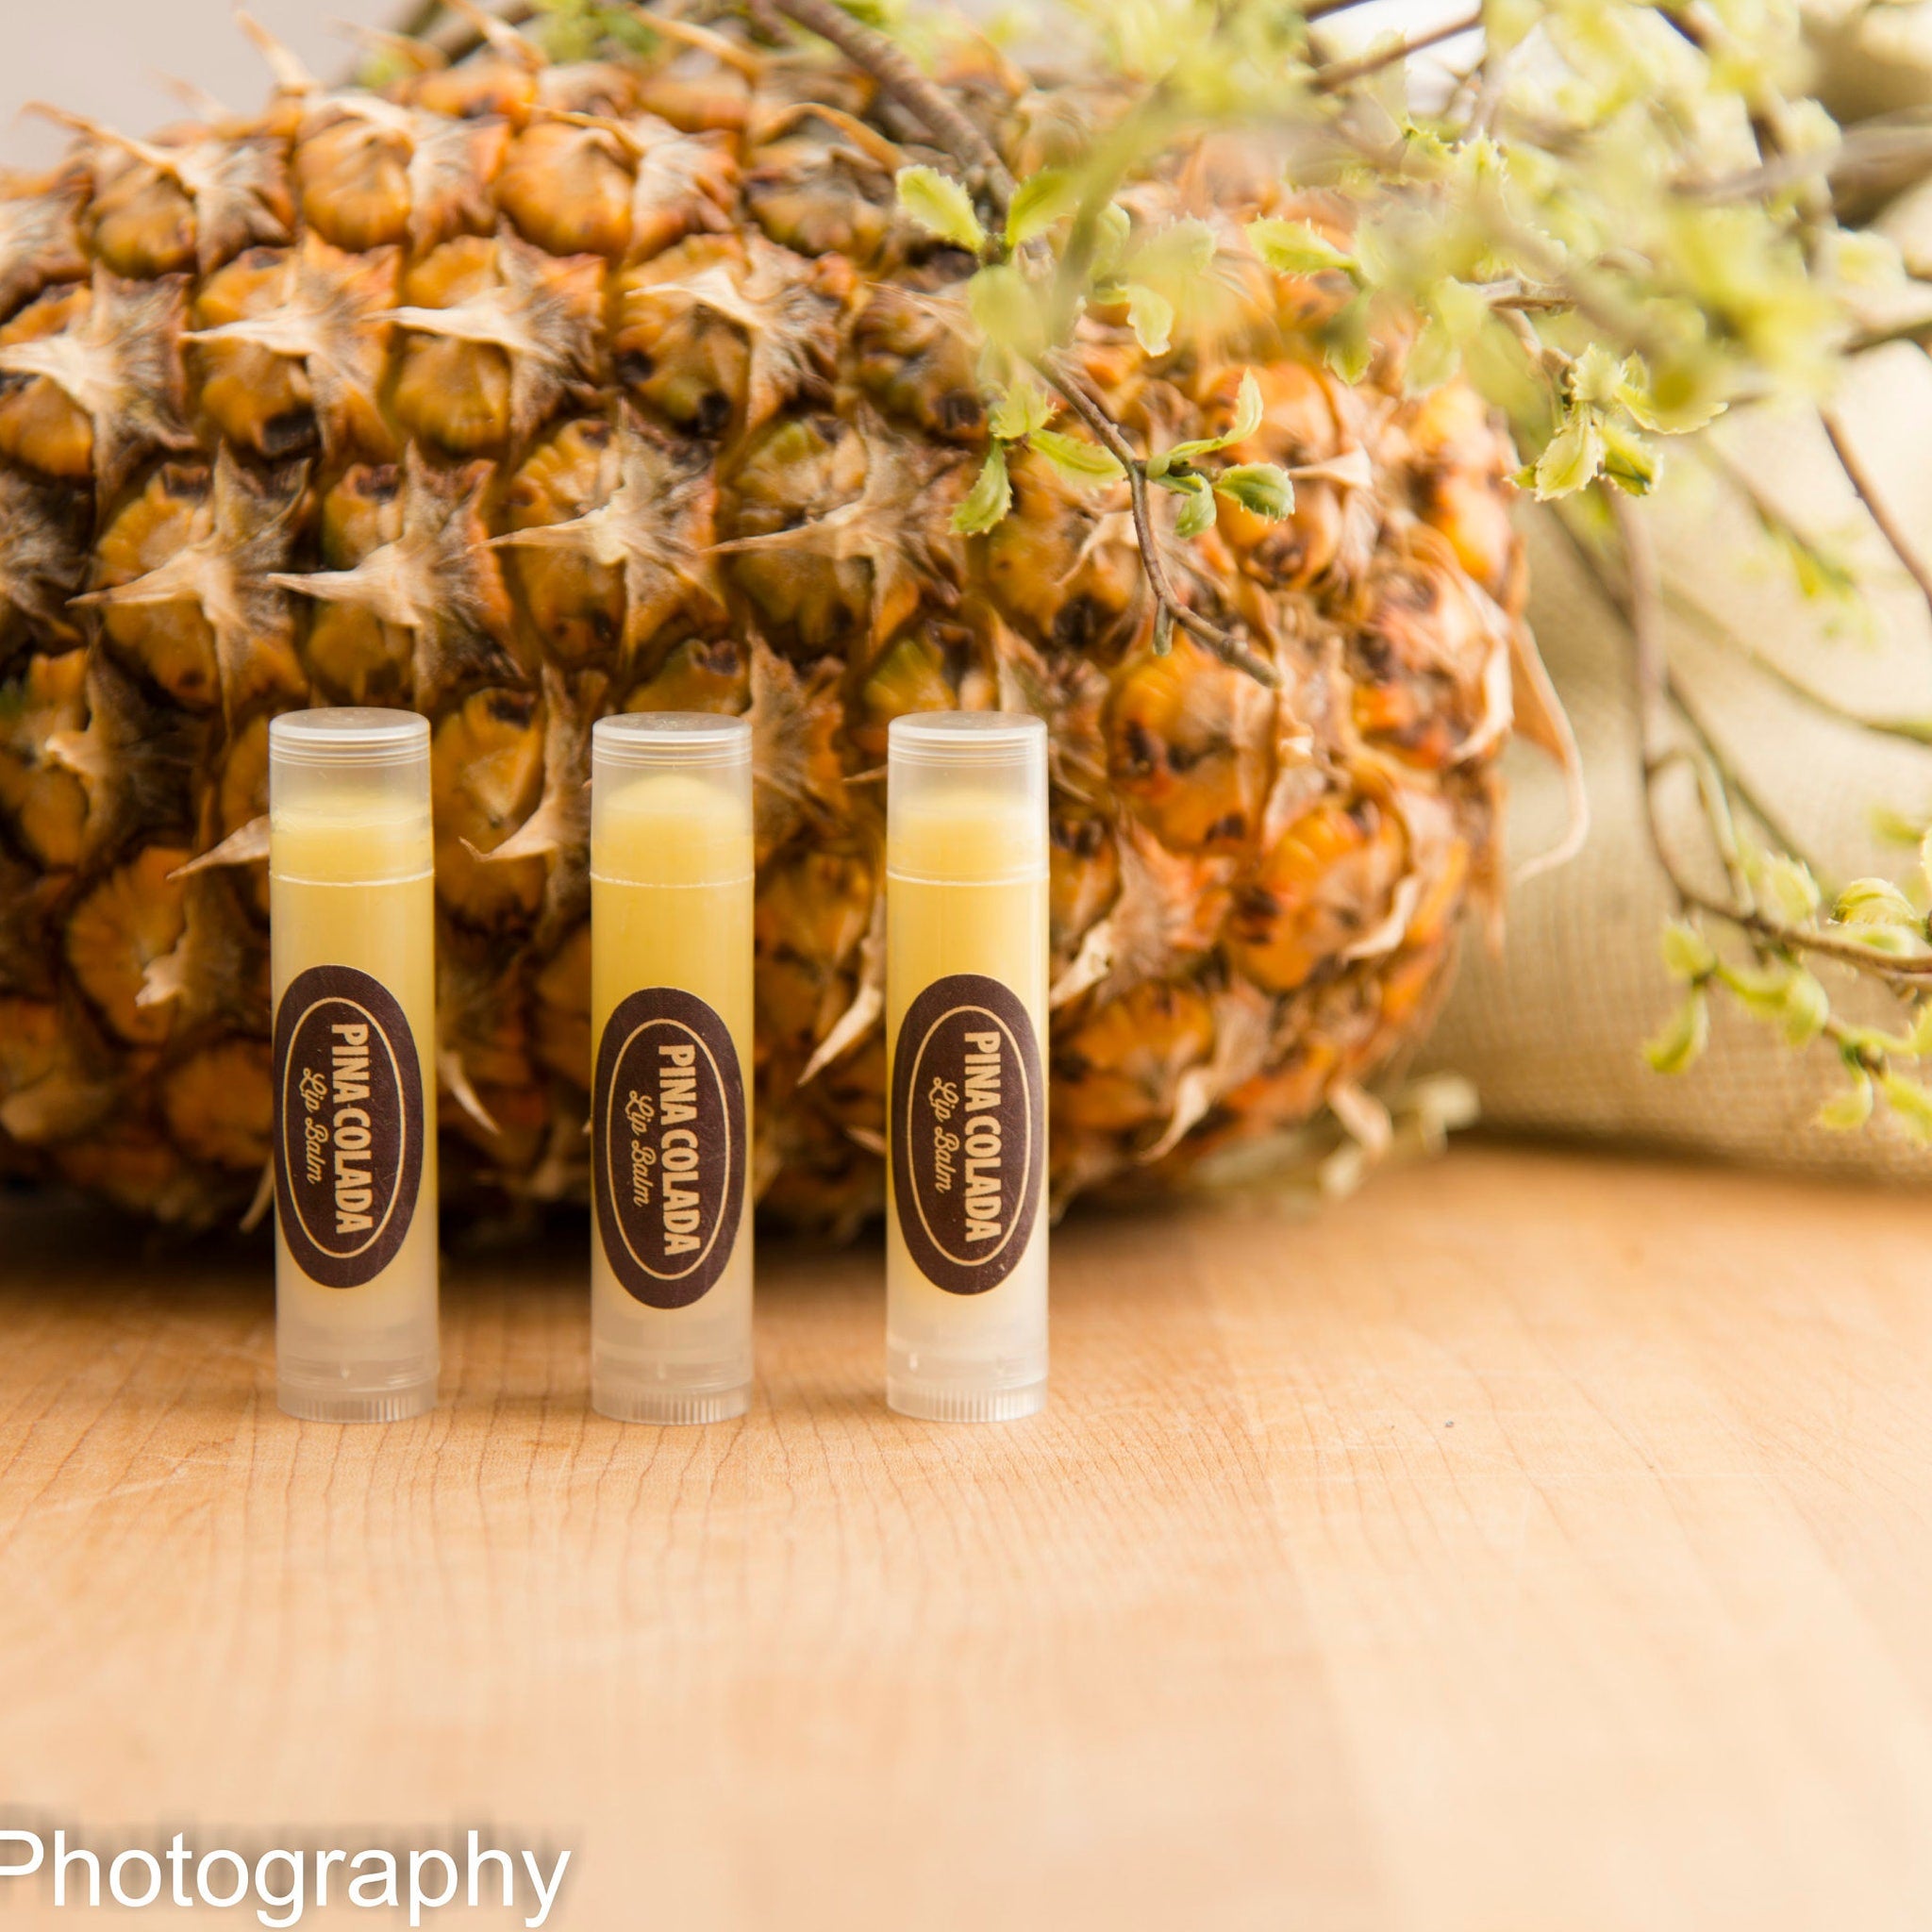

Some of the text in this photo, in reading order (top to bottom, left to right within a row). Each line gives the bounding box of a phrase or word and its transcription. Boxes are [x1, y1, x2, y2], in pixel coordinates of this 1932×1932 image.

[299, 1067, 328, 1184] Lip Balm
[331, 1023, 374, 1234] PINA COLADA
[625, 1090, 657, 1208] Lip Balm
[658, 1043, 701, 1256] PINA COLADA
[928, 1076, 959, 1193] Lip Balm
[964, 1031, 1002, 1241] PINA COLADA
